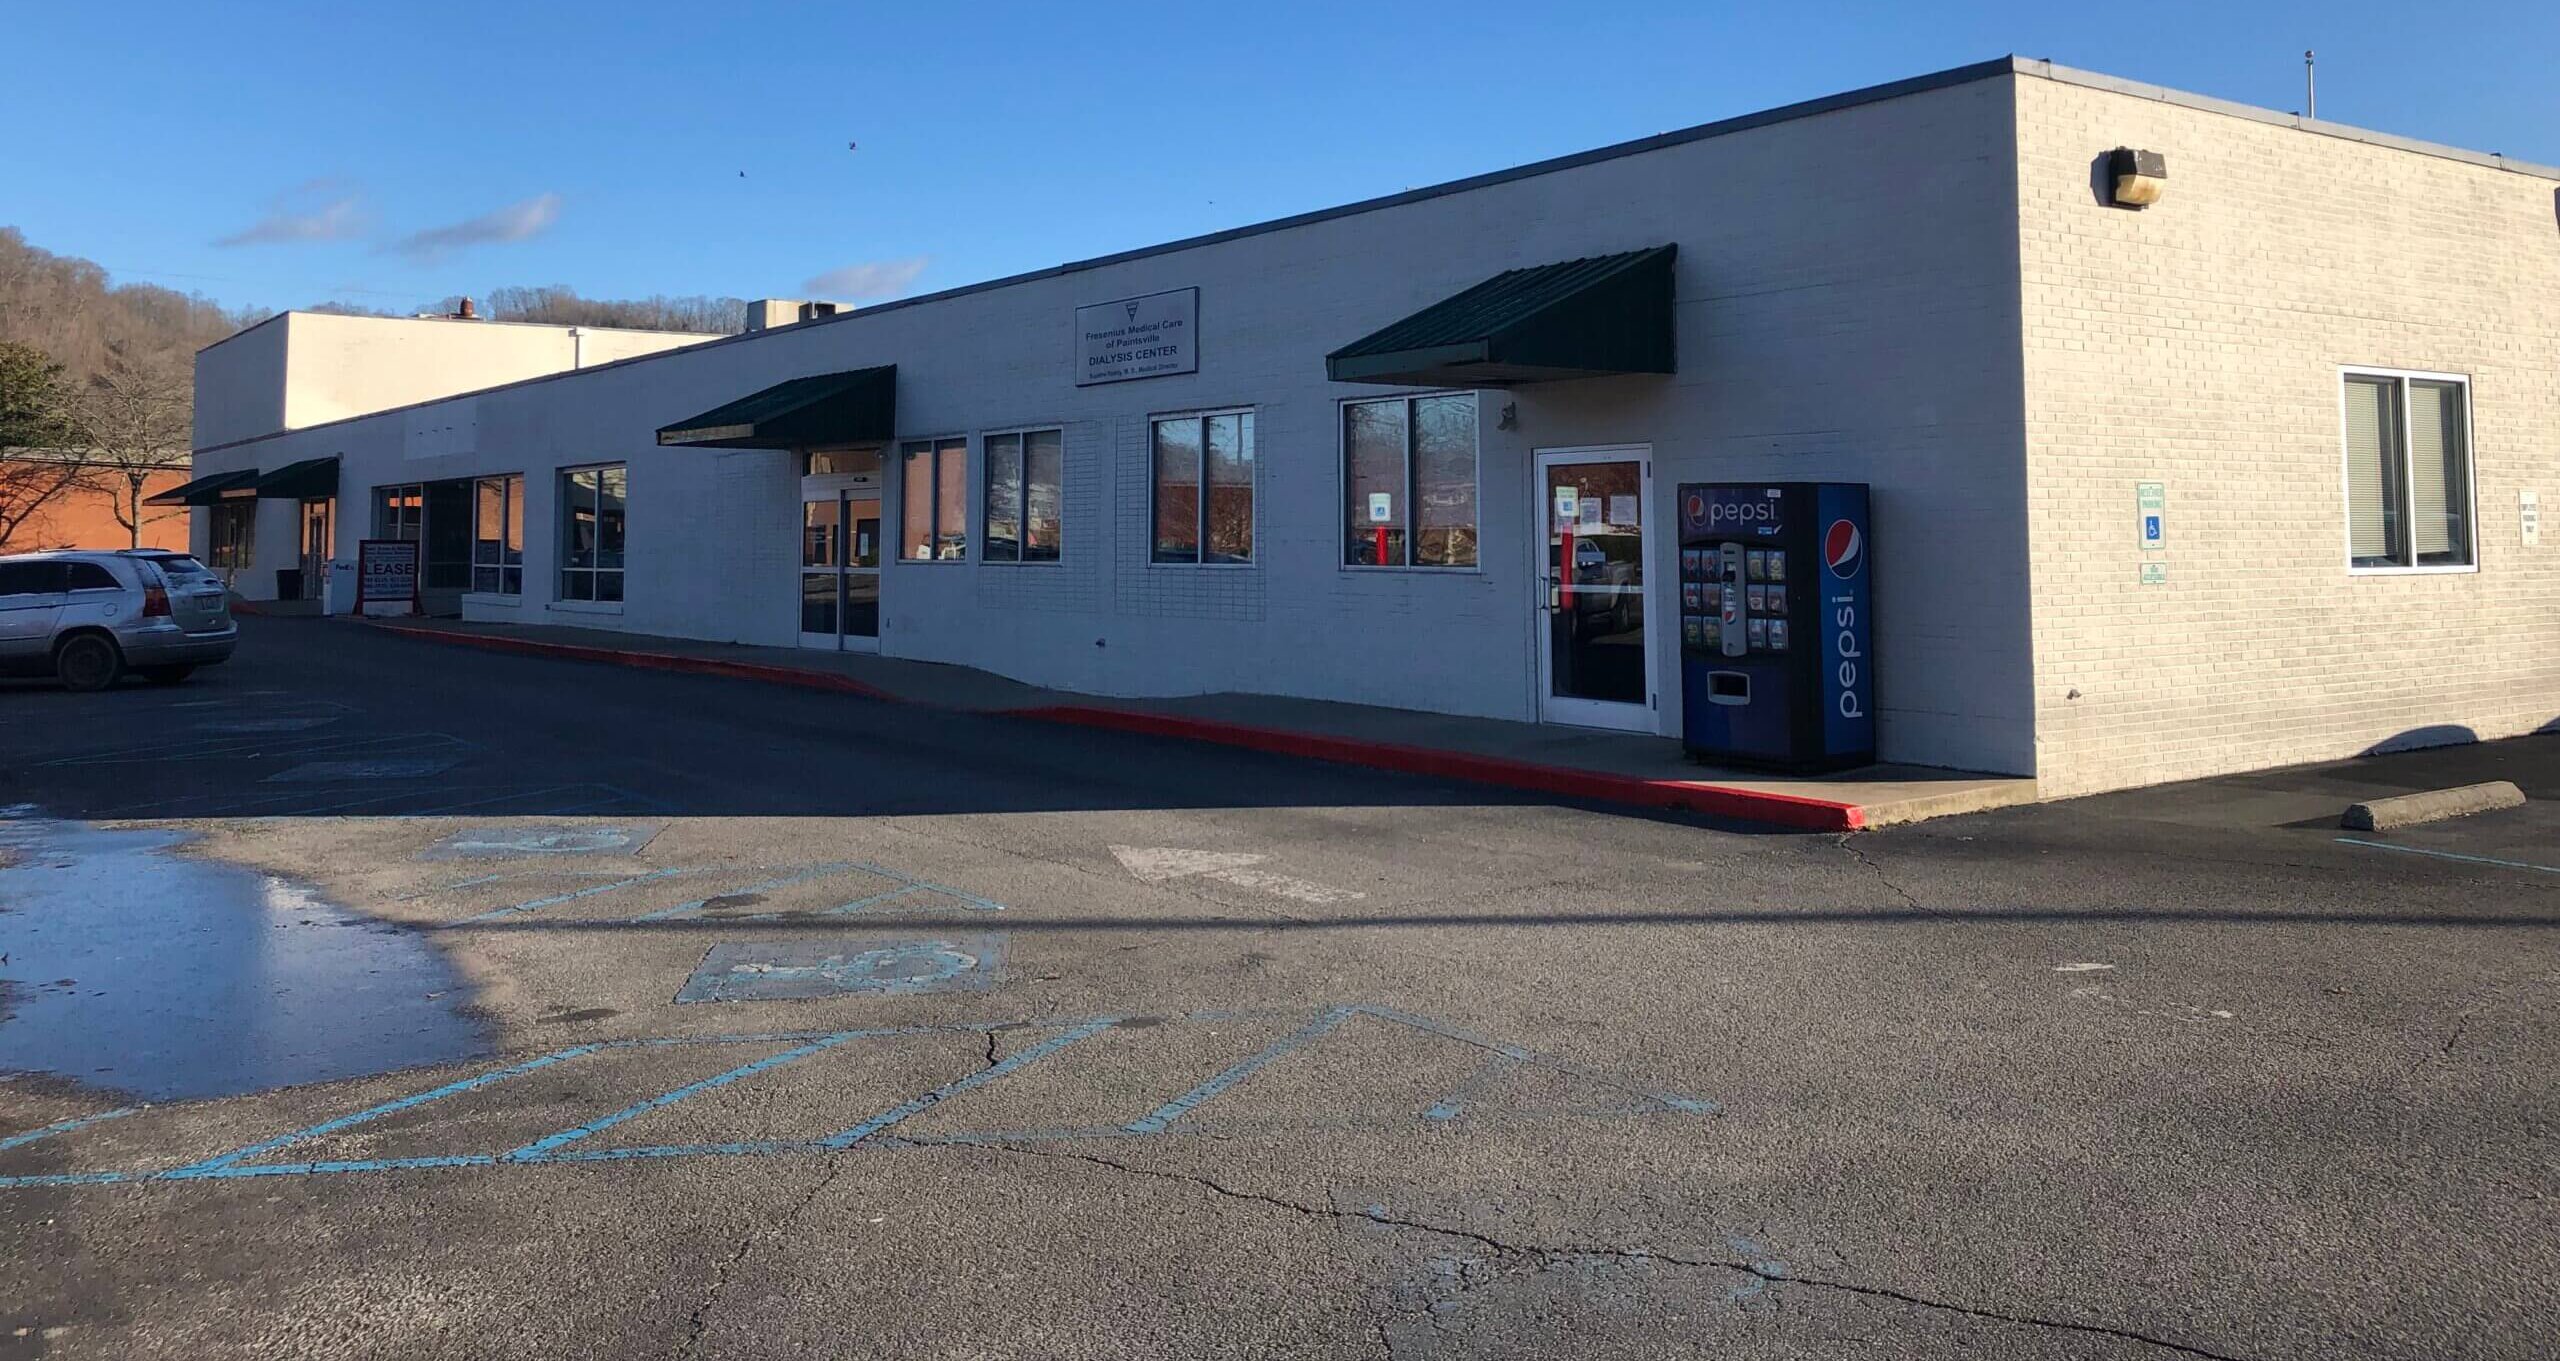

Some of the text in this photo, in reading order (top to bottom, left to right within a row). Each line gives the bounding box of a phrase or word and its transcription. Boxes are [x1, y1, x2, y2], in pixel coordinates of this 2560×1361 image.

[1086, 320, 1183, 341] Fresenius Medical Care
[1105, 334, 1160, 349] of Paintsville
[1089, 345, 1177, 366] DIALYSIS CENTER
[1710, 499, 1776, 526] pepsi
[365, 563, 413, 575] LEASE
[1831, 596, 1863, 718] pepsi
